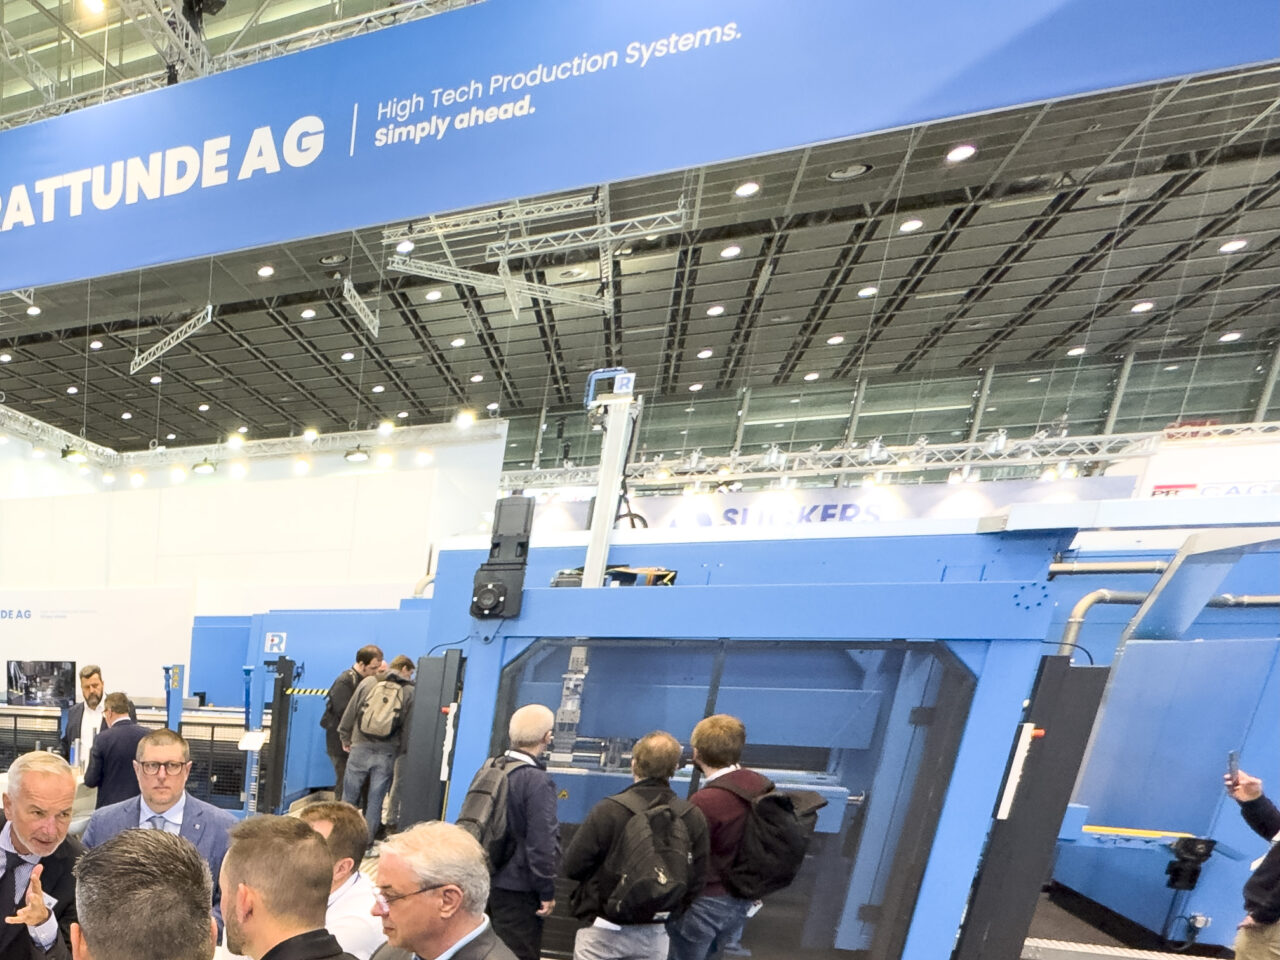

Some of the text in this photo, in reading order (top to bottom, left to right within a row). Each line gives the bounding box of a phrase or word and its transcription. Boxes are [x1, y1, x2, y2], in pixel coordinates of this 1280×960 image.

[377, 20, 742, 122] High Tech Production Systems.
[454, 94, 536, 131] ahead.
[238, 115, 325, 180] AG
[15, 609, 32, 619] AG
